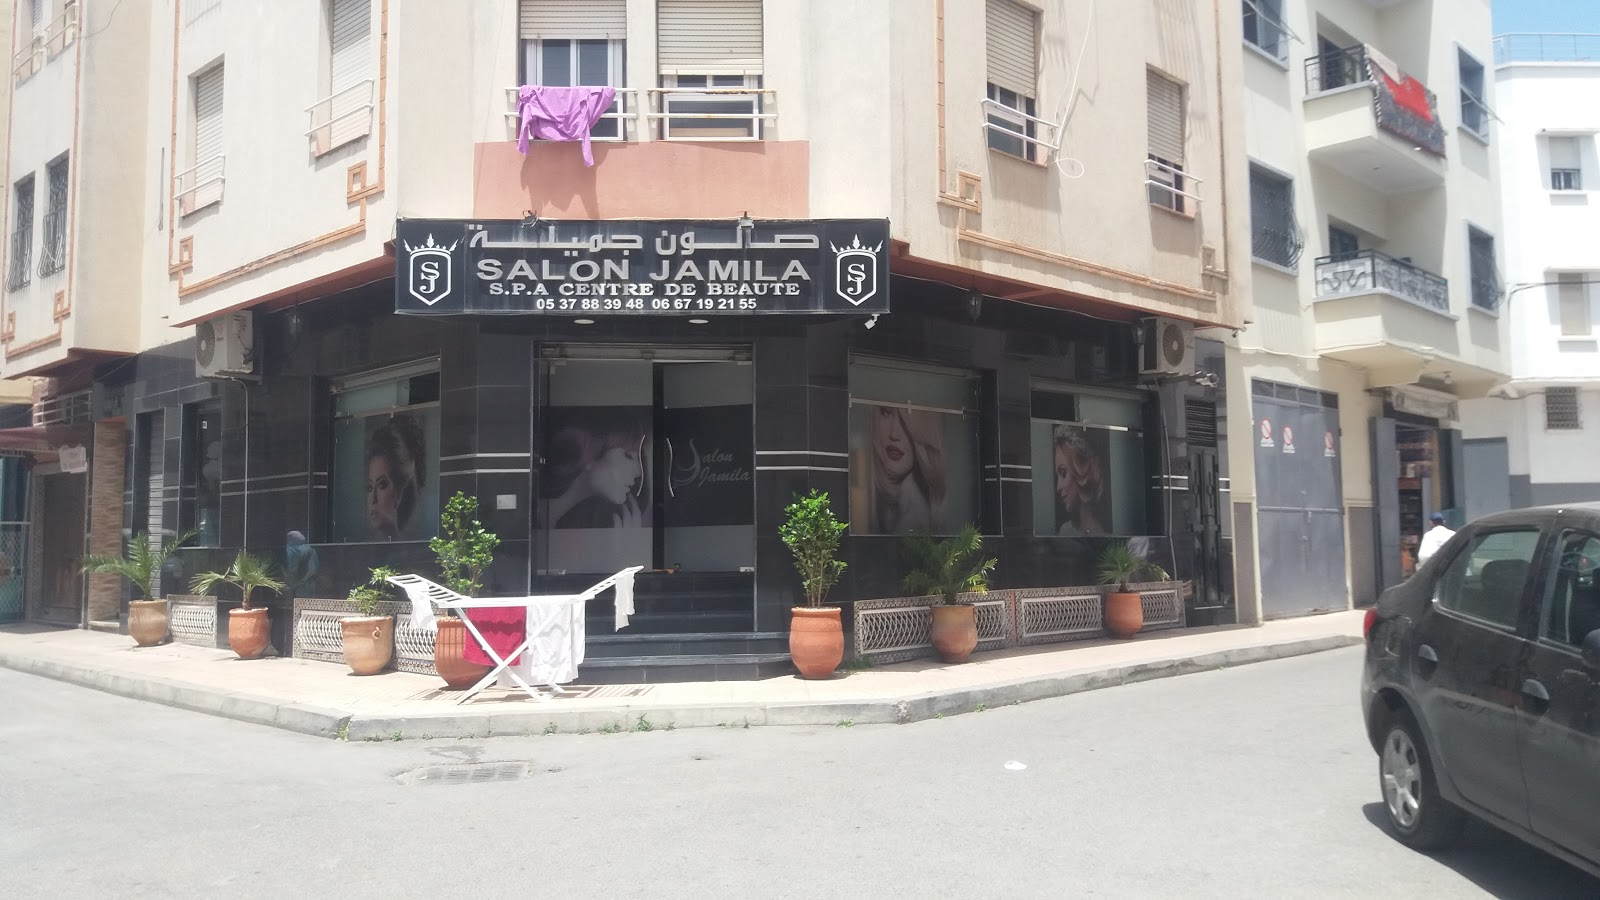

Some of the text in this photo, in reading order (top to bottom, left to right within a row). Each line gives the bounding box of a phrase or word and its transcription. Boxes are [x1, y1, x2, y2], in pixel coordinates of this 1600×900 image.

[468, 224, 820, 256] صالون جميلة
[477, 259, 811, 281] SALON JAMILA
[489, 283, 800, 296] S.P.A CENTRE DE BEAUTE
[536, 298, 757, 310] 05 37 88 39 48 06 67 19 21 55
